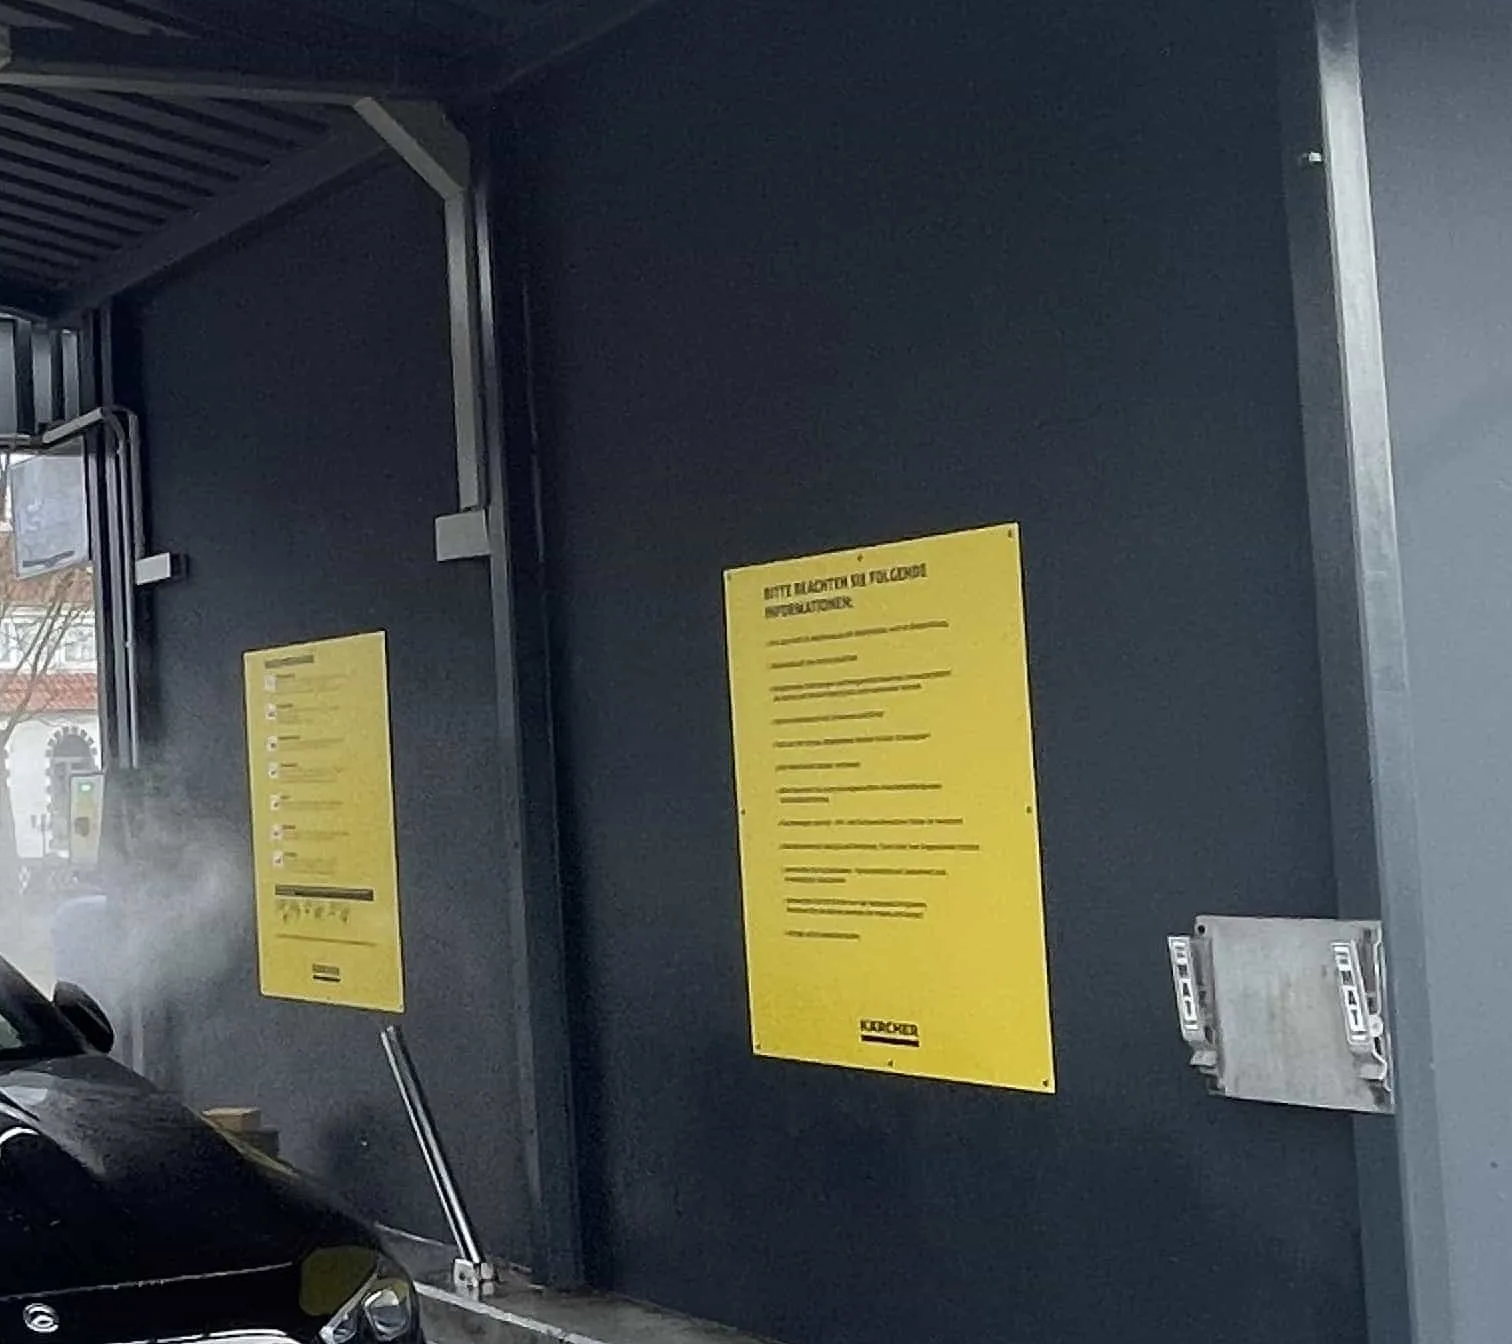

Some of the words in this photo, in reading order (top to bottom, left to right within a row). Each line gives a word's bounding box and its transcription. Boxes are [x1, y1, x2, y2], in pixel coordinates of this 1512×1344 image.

[764, 584, 791, 600] BITTE
[794, 576, 847, 595] BEACHTEN
[869, 563, 927, 584] FOLGENDE
